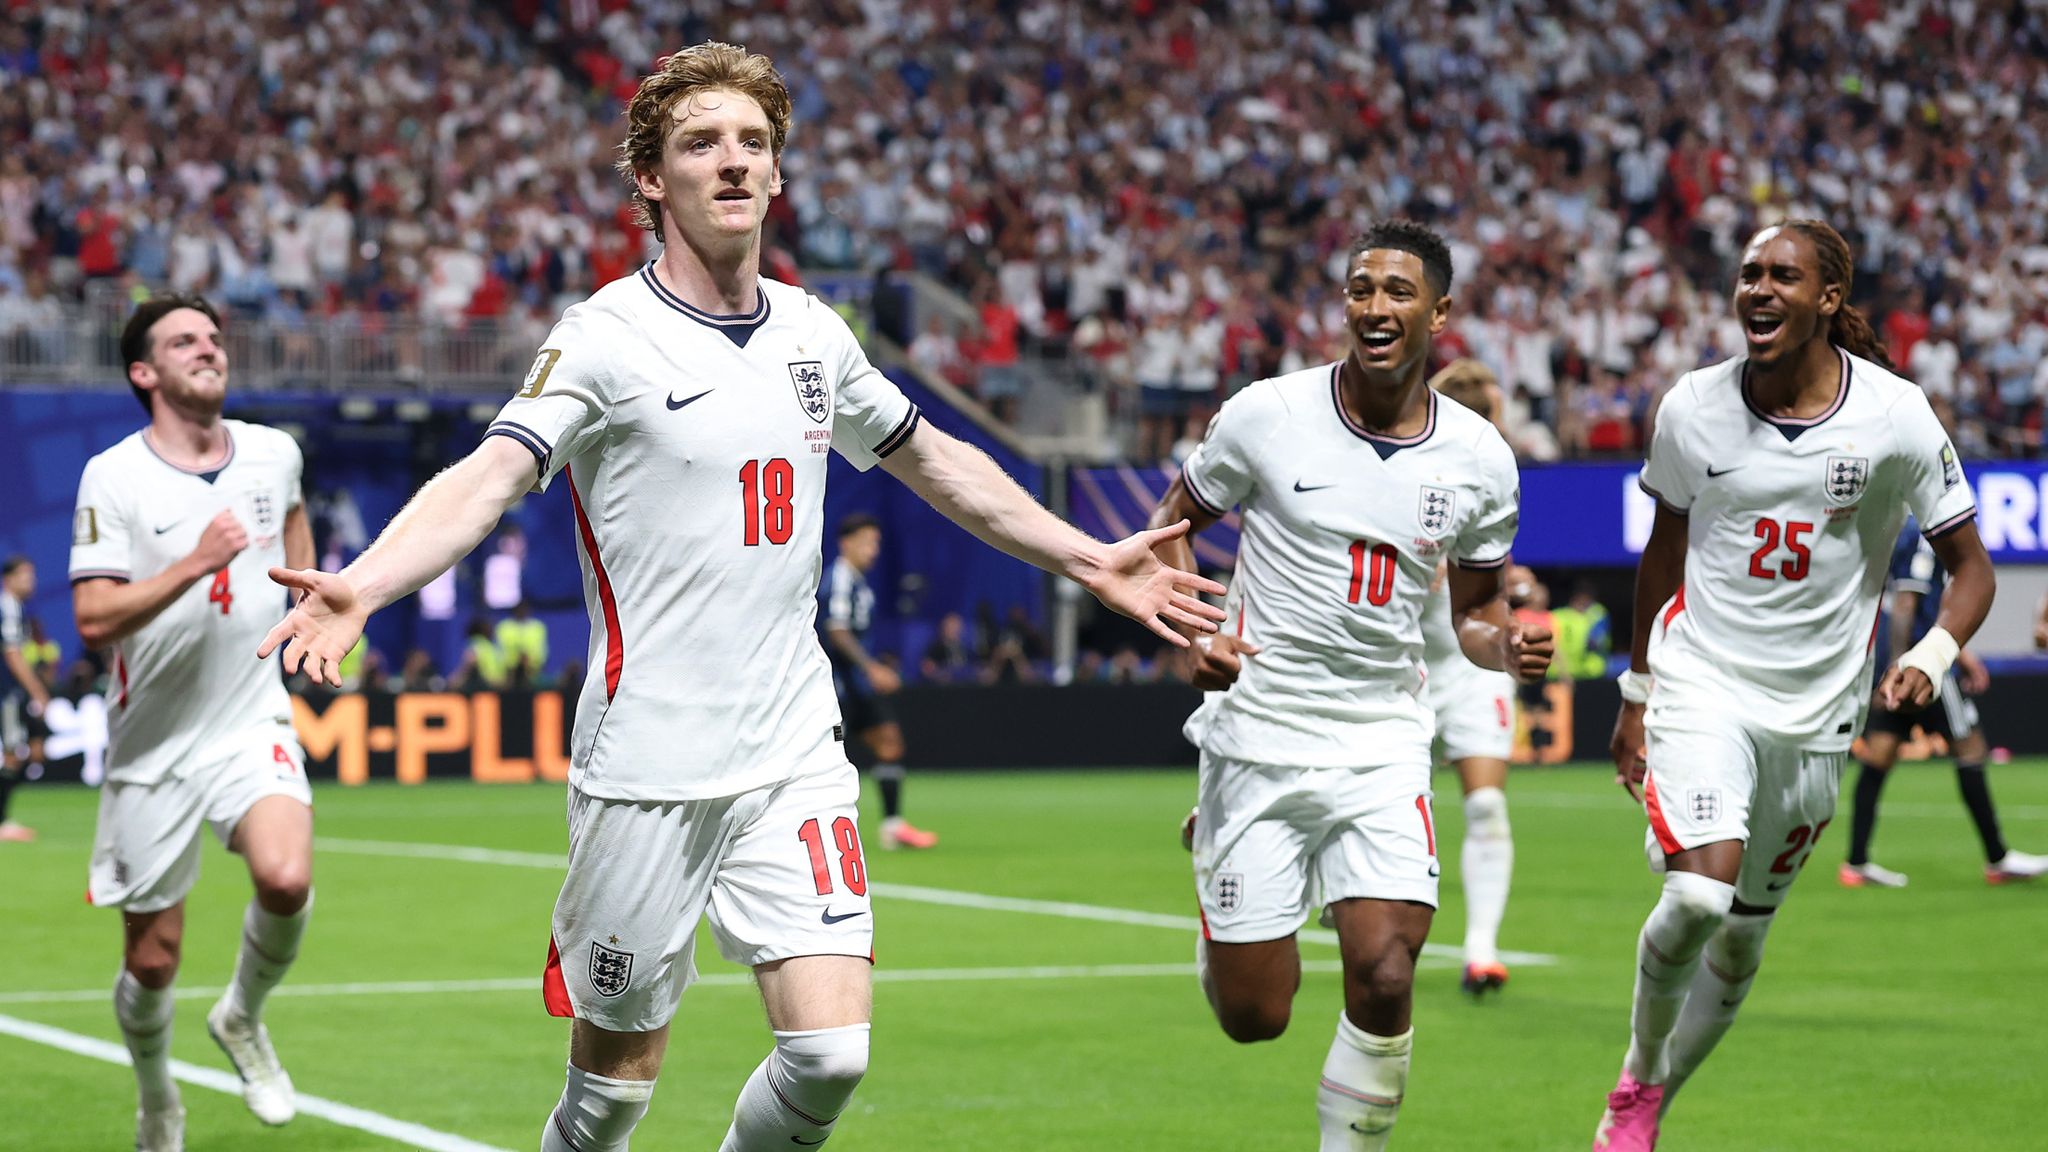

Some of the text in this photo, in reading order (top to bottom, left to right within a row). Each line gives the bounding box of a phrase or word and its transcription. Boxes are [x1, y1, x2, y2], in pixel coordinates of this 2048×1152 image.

[739, 457, 794, 547] 18
[1347, 539, 1398, 607] 10
[1749, 517, 1813, 581] 25
[209, 566, 233, 615] 4
[273, 744, 297, 774] 4
[798, 815, 867, 897] 18
